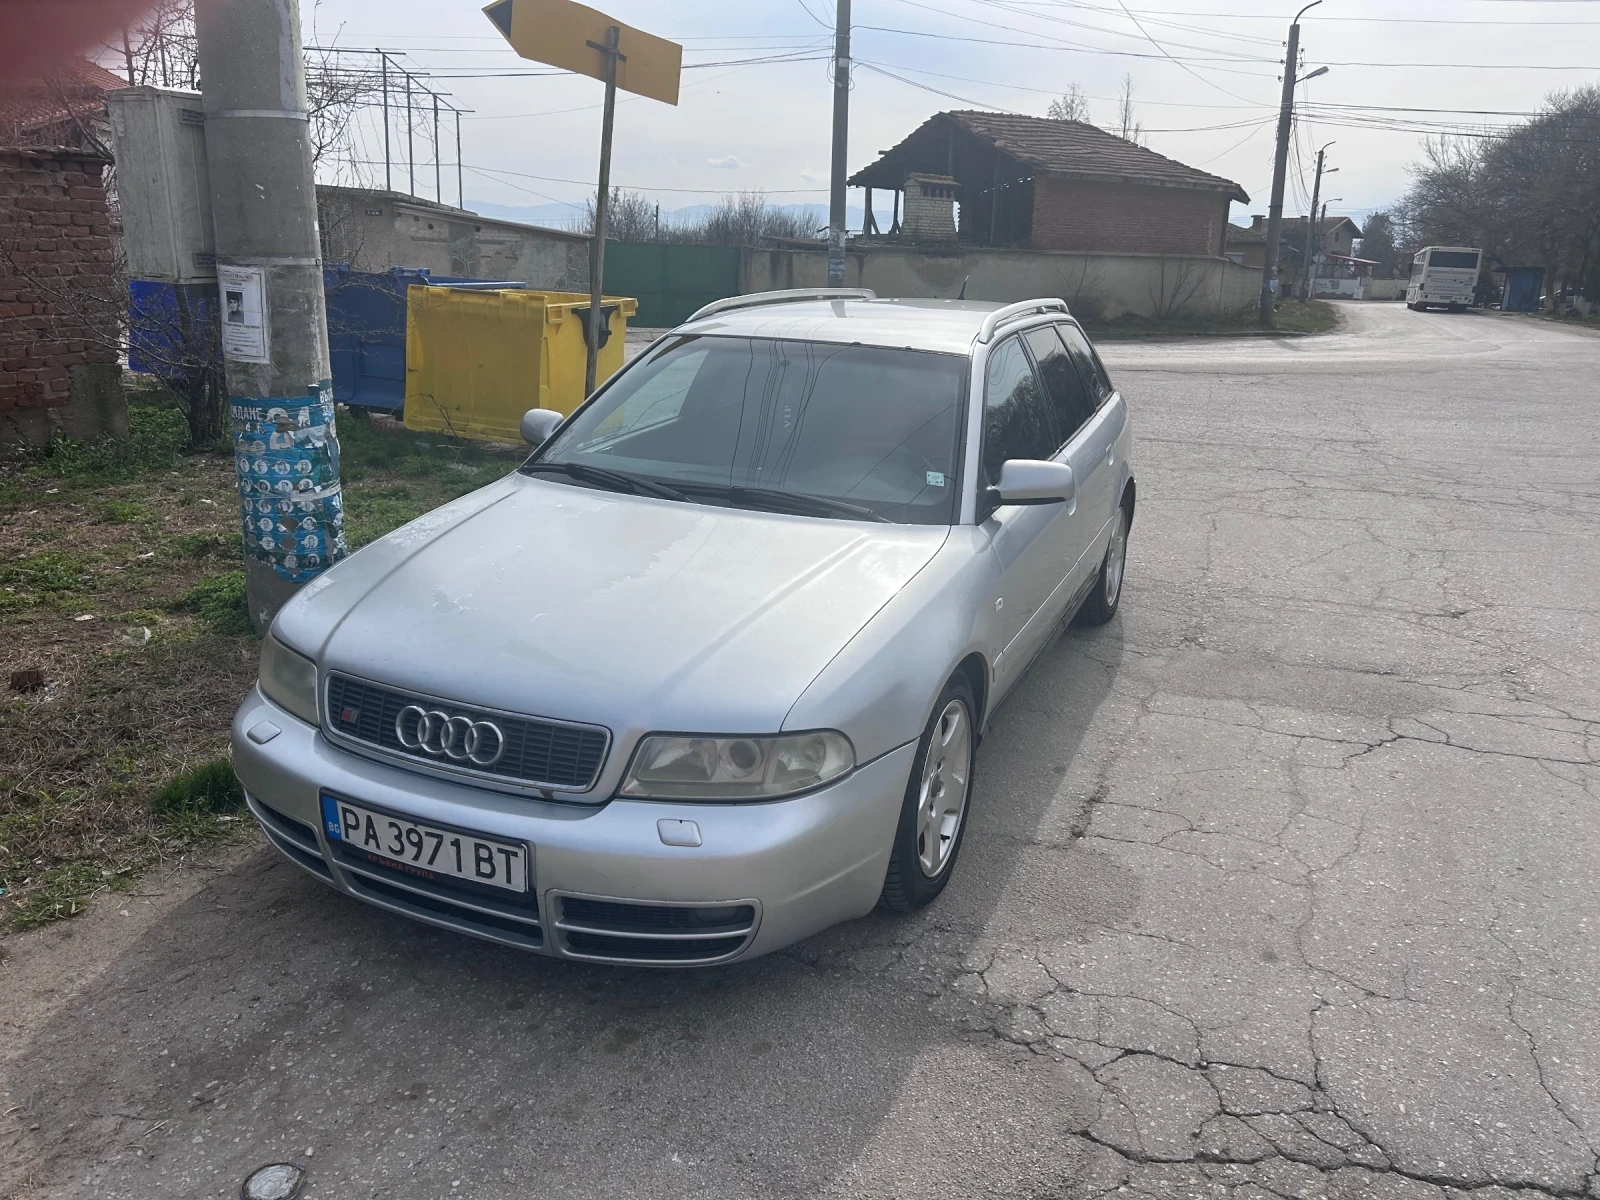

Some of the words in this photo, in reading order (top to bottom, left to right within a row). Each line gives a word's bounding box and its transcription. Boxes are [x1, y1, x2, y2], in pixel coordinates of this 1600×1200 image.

[328, 821, 340, 833] BG
[388, 821, 462, 873] 3971
[405, 866, 435, 880] ГРУПА
